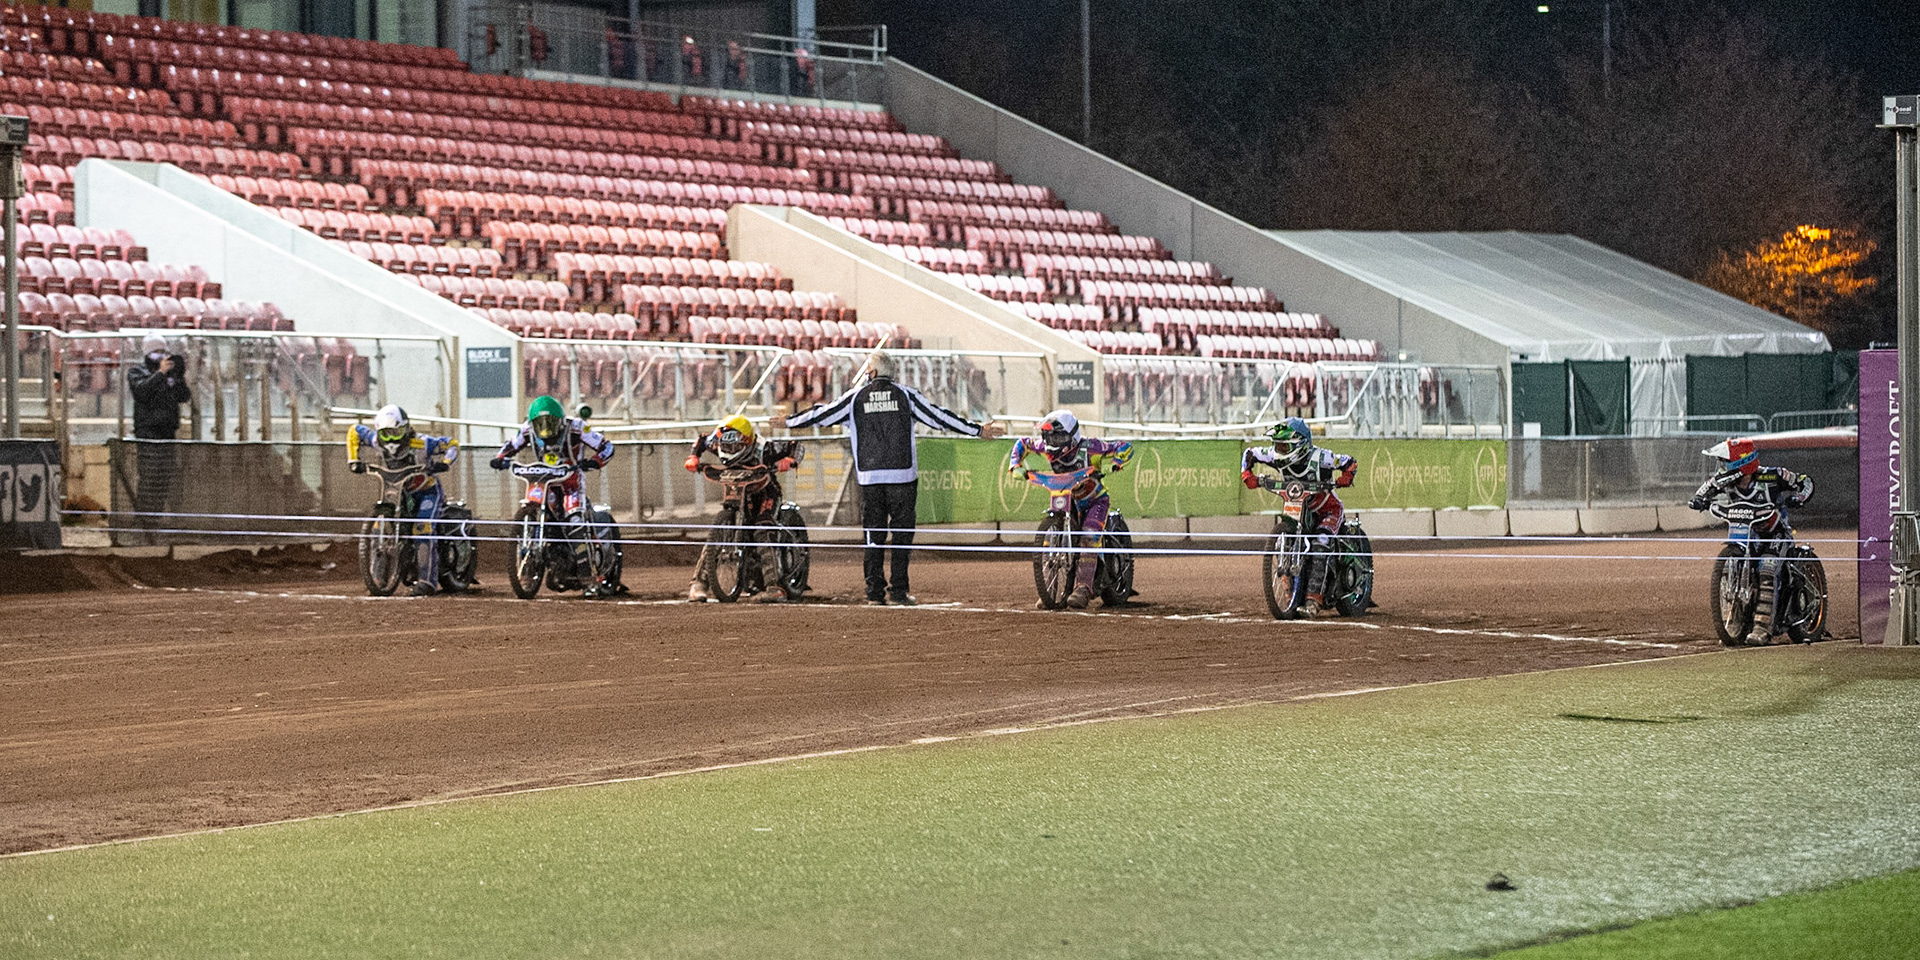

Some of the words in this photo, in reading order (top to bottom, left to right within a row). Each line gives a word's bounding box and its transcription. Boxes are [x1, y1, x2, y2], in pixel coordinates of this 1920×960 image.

[469, 350, 492, 358] BLOCK
[869, 391, 891, 401] START
[864, 401, 899, 413] MARSHALL
[1200, 468, 1231, 488] EVENTS
